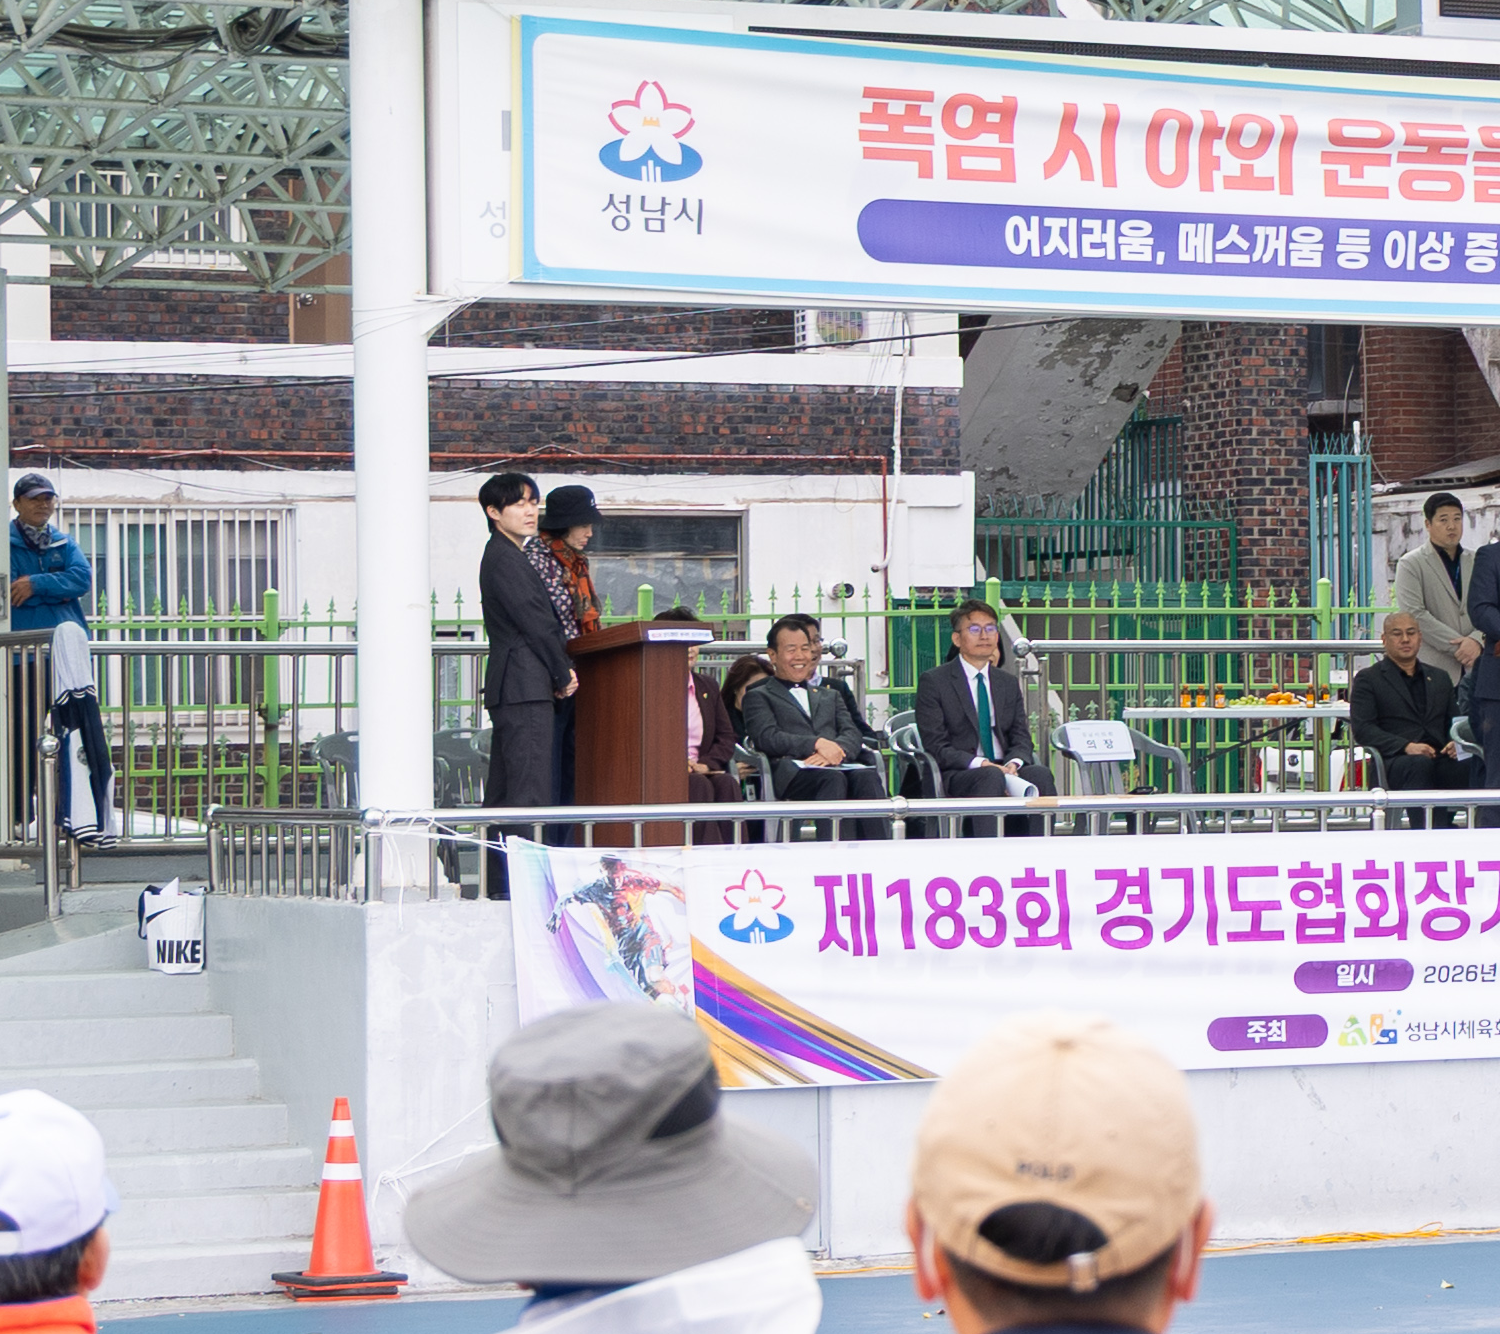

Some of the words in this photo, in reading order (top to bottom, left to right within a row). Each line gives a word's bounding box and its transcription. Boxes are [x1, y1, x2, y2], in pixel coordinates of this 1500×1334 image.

[858, 86, 1018, 184] 폭염
[1043, 102, 1120, 188] 시
[1145, 108, 1298, 196] 야외
[601, 192, 704, 236] 성남시
[1005, 214, 1165, 266] 어지러움,
[1178, 222, 1323, 268] 메스꺼움
[1335, 227, 1372, 269] 등
[1383, 229, 1454, 272] 이상
[813, 866, 1073, 957] 제183회
[157, 939, 201, 964] NIKE
[1335, 963, 1375, 987] 일시
[1423, 962, 1497, 984] 2026년
[1246, 1019, 1287, 1044] 주최
